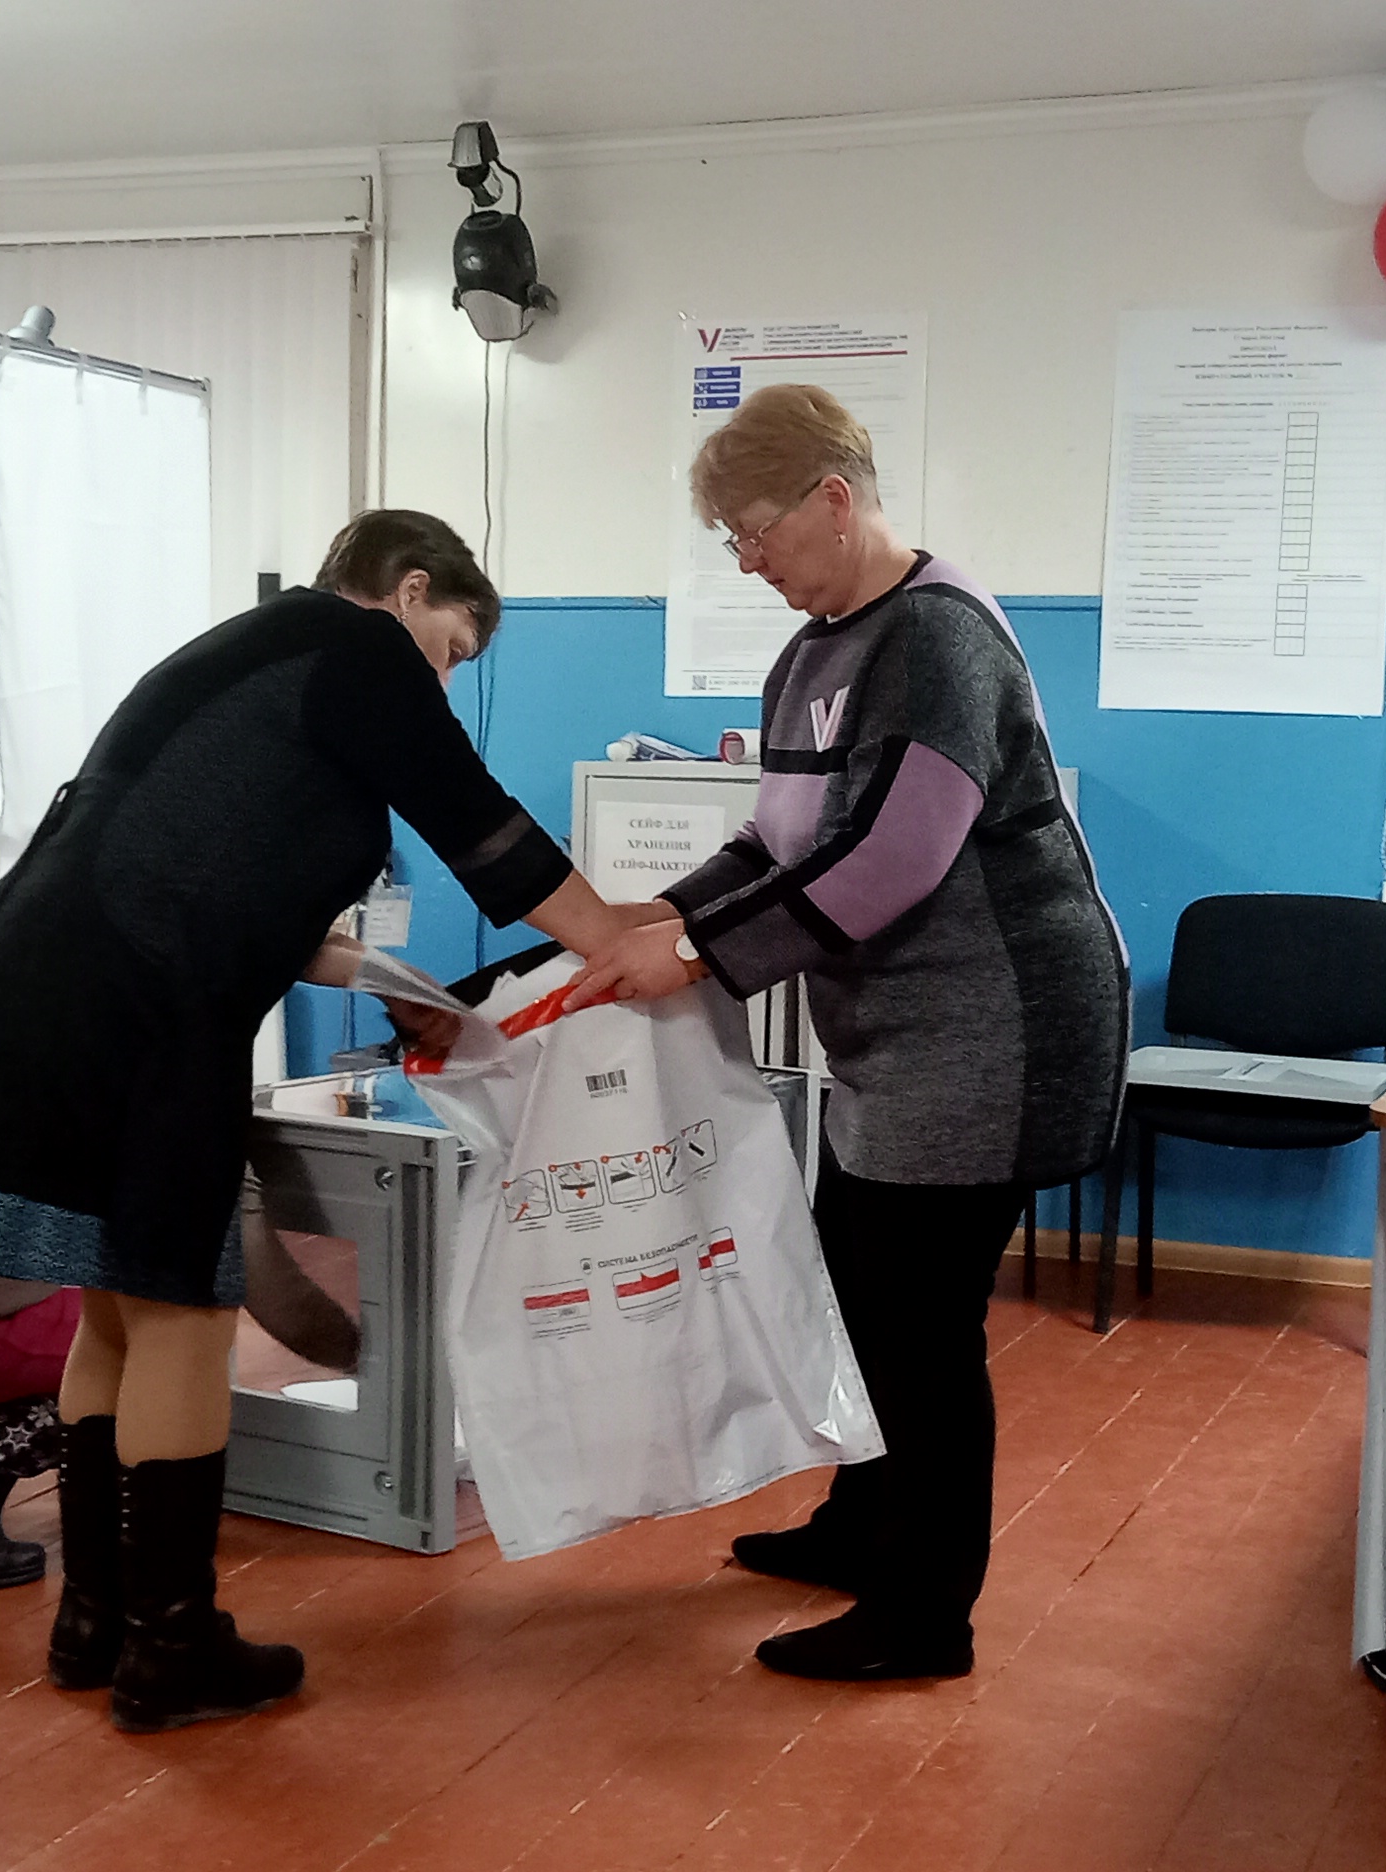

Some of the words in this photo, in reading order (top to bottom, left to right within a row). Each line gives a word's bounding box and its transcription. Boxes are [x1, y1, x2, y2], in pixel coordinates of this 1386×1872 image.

[629, 817, 663, 829] СЕЙФ
[627, 839, 691, 851] ХРАНЕНИЯ
[597, 1255, 639, 1269] СИСТЕМА
